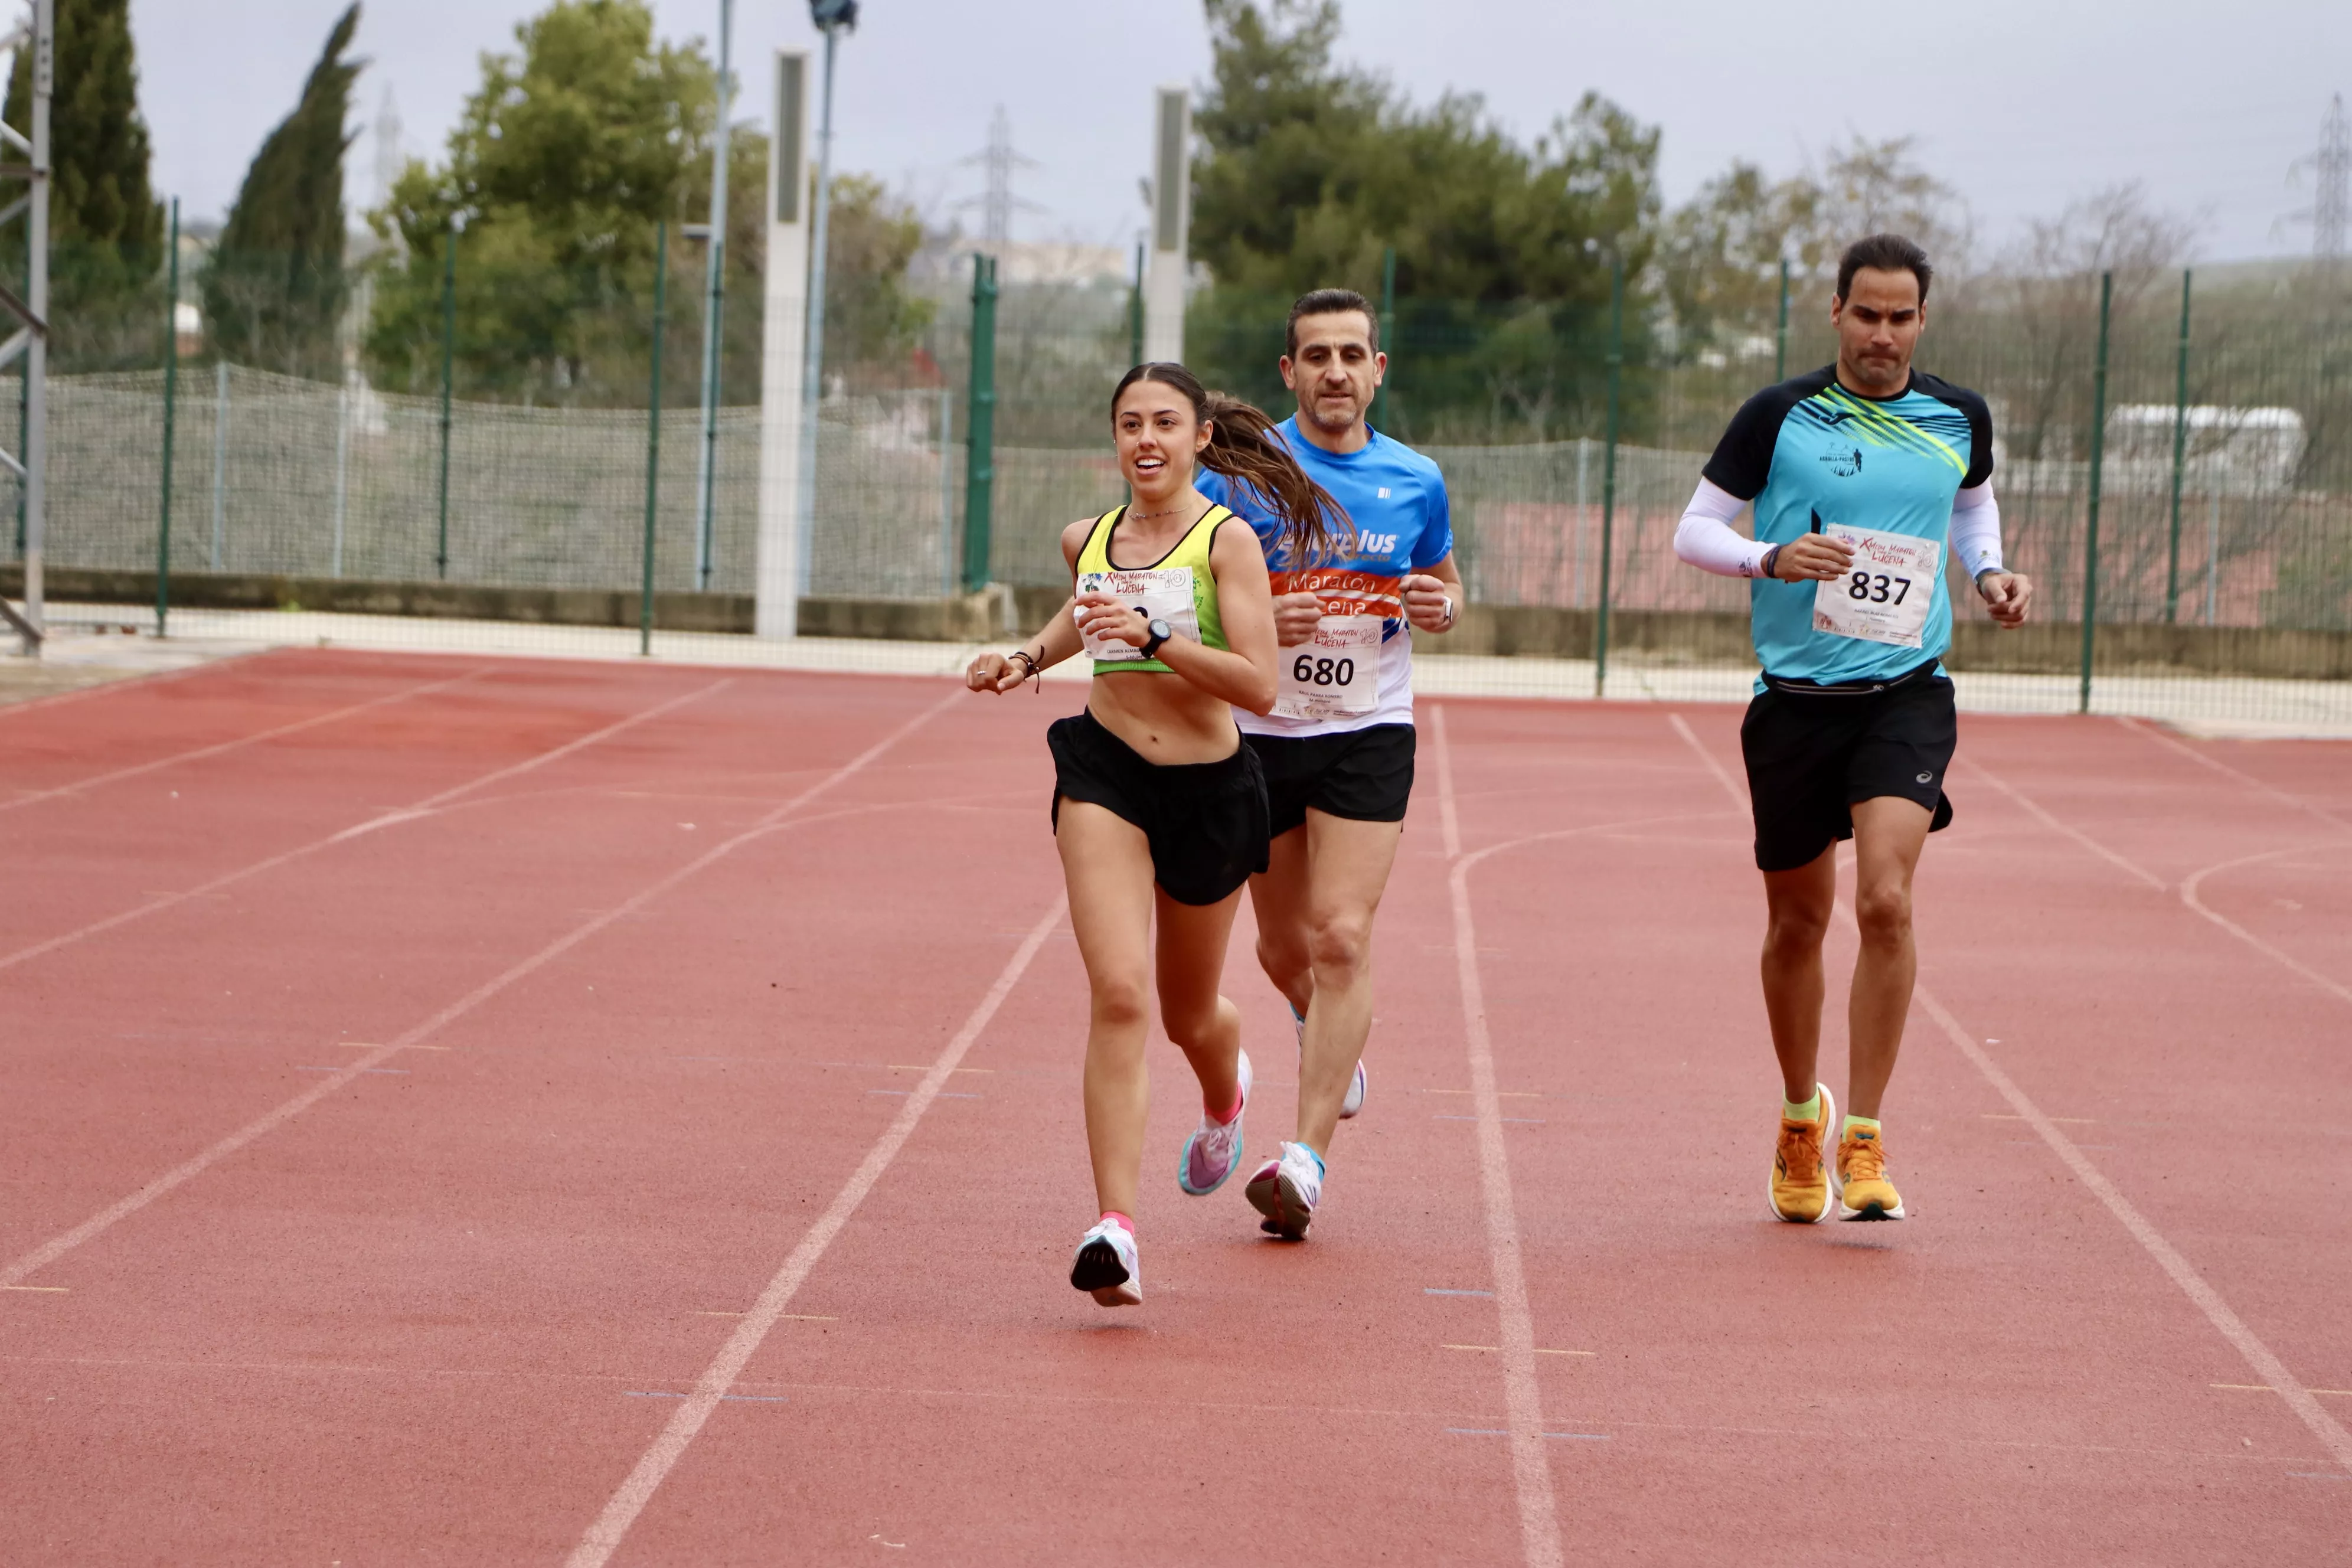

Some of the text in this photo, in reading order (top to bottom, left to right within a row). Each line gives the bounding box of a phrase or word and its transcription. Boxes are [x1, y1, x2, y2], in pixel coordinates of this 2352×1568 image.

[1871, 551, 1908, 567] LUCENA
[1104, 571, 1115, 584] X
[1288, 573, 1376, 593] Maratón
[1116, 582, 1150, 594] LUCENA
[1848, 571, 1912, 606] 837
[1314, 635, 1350, 648] LUCENA
[1293, 654, 1355, 686] 680
